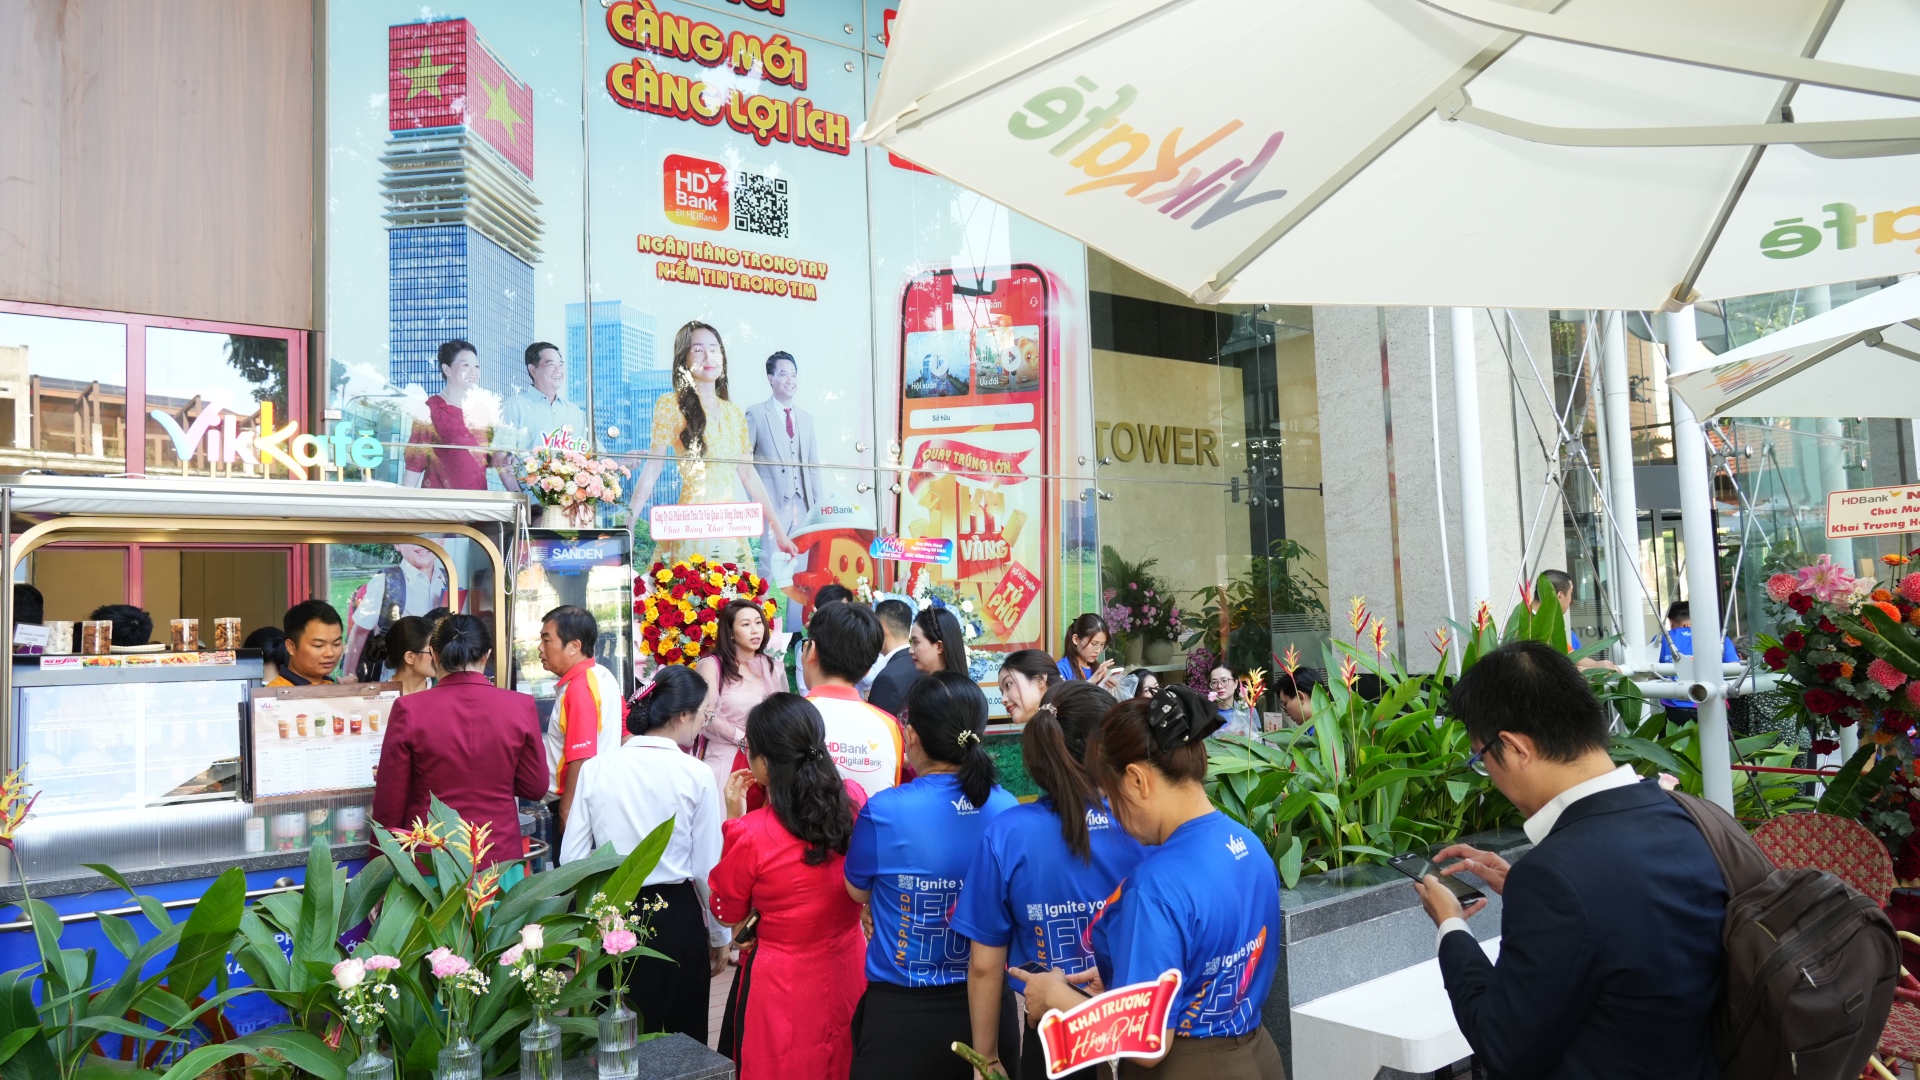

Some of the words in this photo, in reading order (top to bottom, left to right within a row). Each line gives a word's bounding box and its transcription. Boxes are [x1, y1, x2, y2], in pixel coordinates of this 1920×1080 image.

[608, 1, 724, 63] CÀNG
[730, 33, 804, 85] MỚI
[609, 59, 724, 119] CÀNG
[730, 89, 788, 138] LỢI
[796, 98, 847, 148] ÍCH
[675, 169, 709, 194] HD
[675, 189, 718, 212] Bank
[687, 210, 718, 223] HDBank
[638, 234, 688, 257] NGÂN
[692, 241, 740, 264] HÀNG
[742, 250, 798, 274] TRONG
[800, 260, 828, 280] TAY
[656, 258, 699, 284] NIỀM
[702, 268, 728, 288] TIN
[731, 272, 787, 297] TRONG
[789, 281, 817, 301] TIM
[1095, 420, 1220, 467] TOWER
[922, 448, 952, 462] QUAY
[953, 451, 988, 472] TRÚNG
[990, 458, 1012, 474] LỚN
[821, 505, 853, 515] HDBank
[1842, 495, 1888, 505] HDBank
[1871, 507, 1897, 516] Chúc
[1832, 523, 1859, 533] Khai
[552, 548, 603, 560] SANDEN
[874, 533, 905, 553] Vikki
[959, 534, 1009, 561] VÀNG
[987, 593, 1020, 629] PHÚ
[826, 742, 867, 755] HDBank
[1225, 834, 1247, 855] Vikki
[915, 876, 956, 891] Ignite
[1045, 901, 1086, 918] Ignite
[895, 893, 911, 966] INSPIRED
[1246, 937, 1264, 957] your
[1068, 1007, 1102, 1034] KHAI
[1101, 991, 1152, 1018] TRƯƠNG
